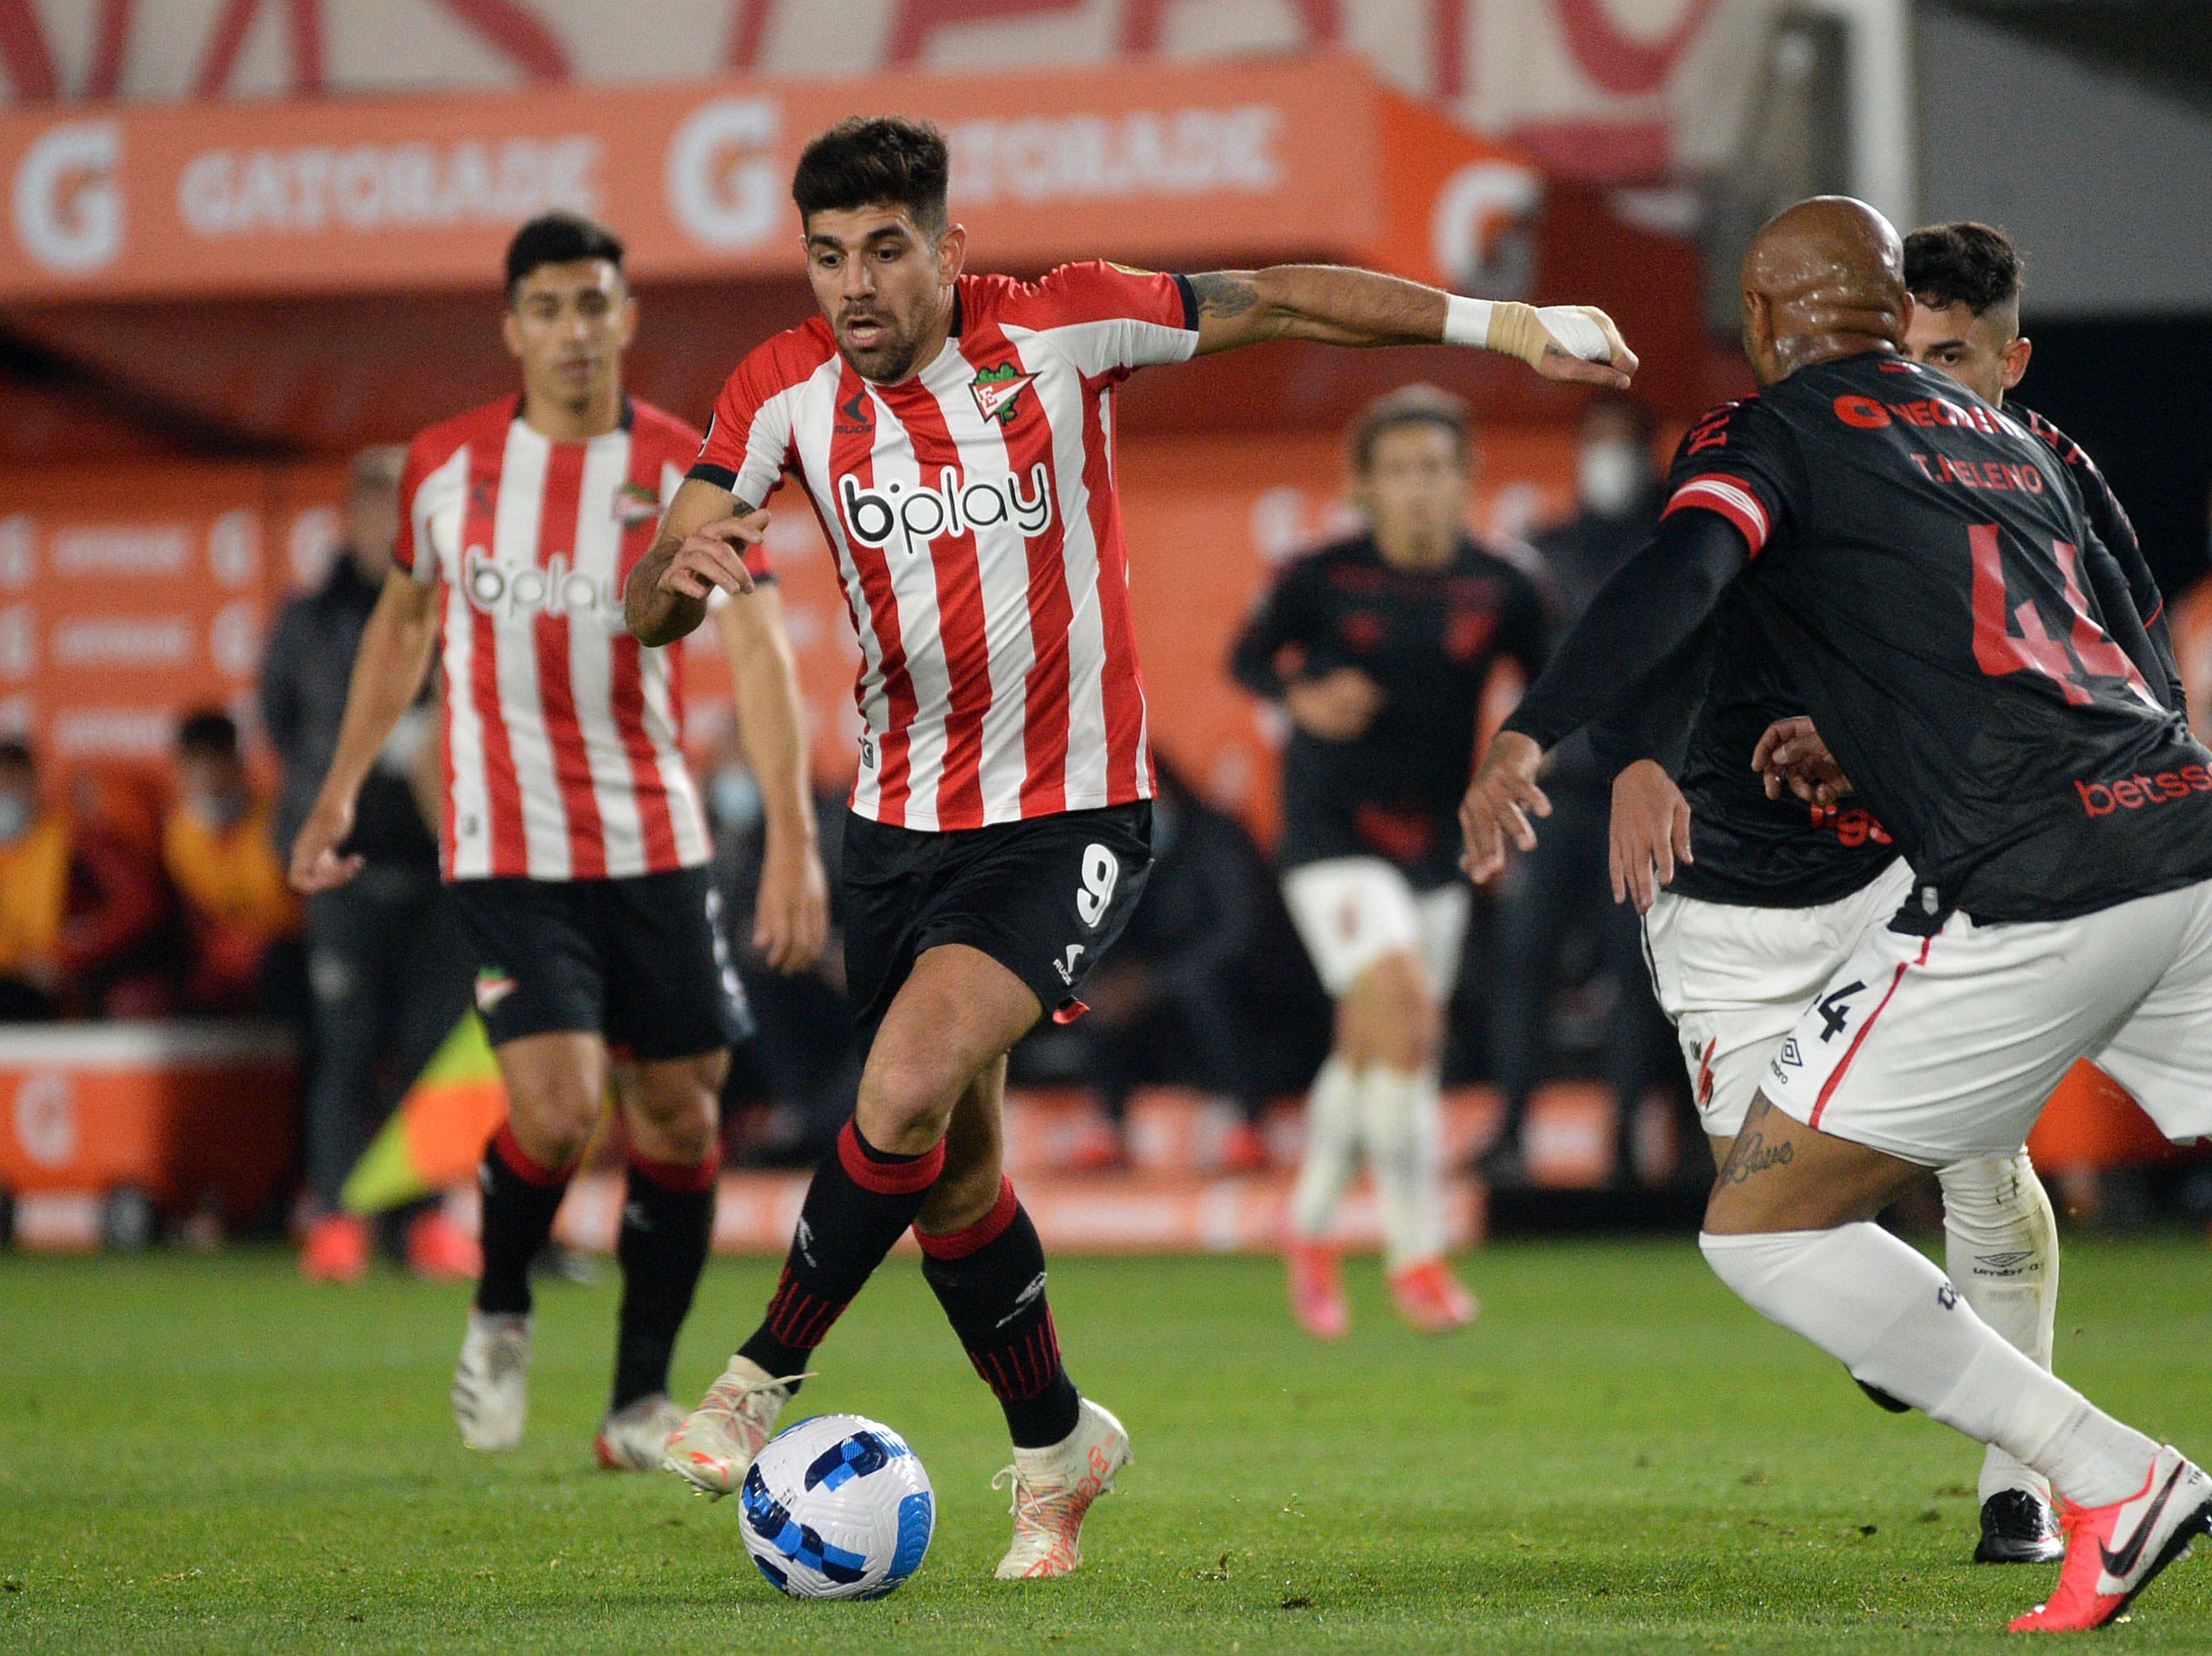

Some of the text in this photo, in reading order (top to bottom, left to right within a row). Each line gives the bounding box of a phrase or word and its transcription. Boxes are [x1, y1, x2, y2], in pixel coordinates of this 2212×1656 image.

[13, 120, 604, 274] G GATORADE
[950, 104, 1280, 200] TORADE
[839, 463, 1052, 560] bplay
[1968, 522, 2166, 715] 44
[2073, 762, 2212, 818] betss
[1077, 843, 1118, 928] 9
[1770, 1058, 1789, 1085] mbro
